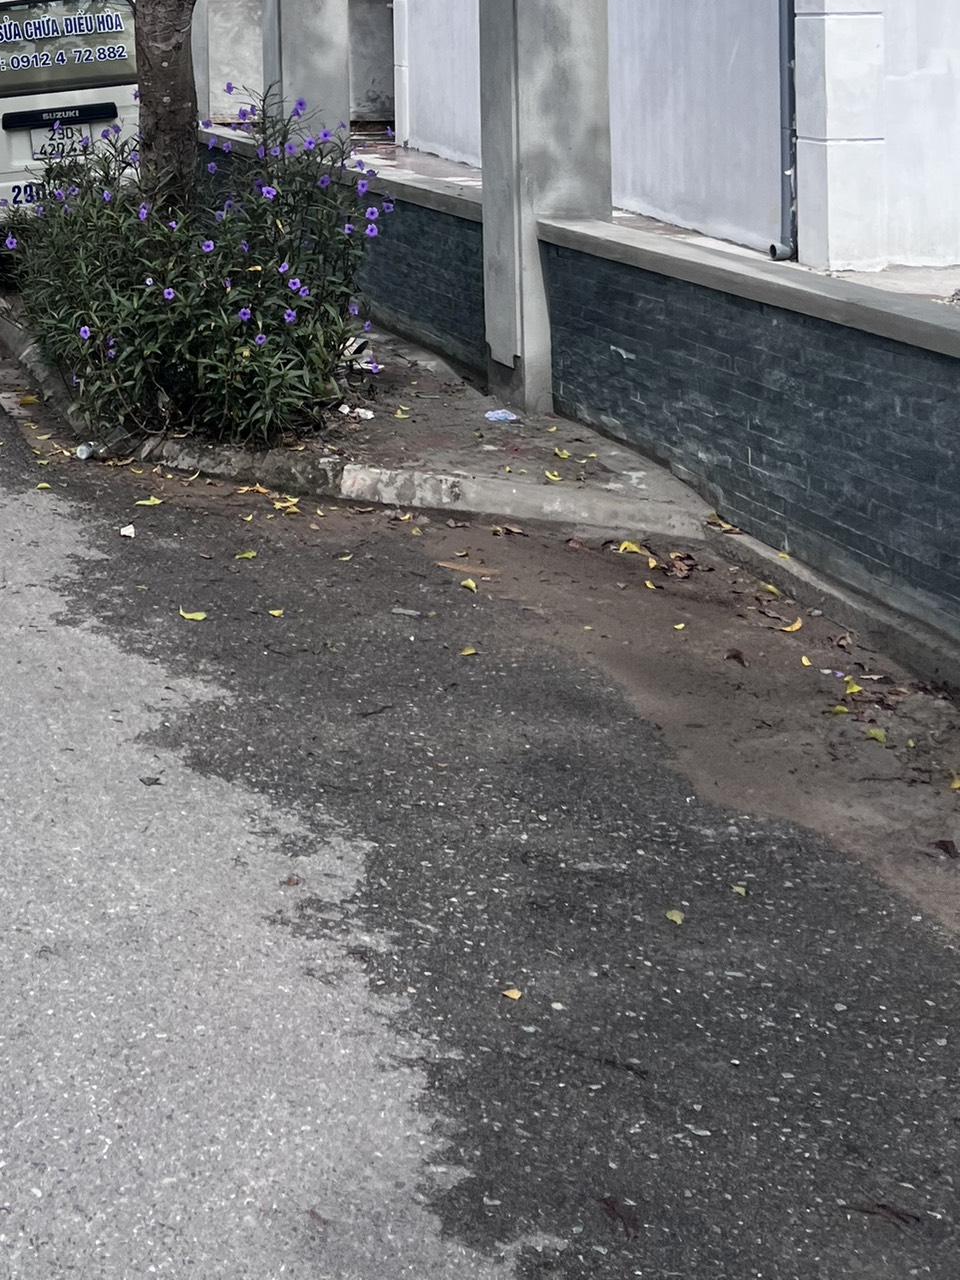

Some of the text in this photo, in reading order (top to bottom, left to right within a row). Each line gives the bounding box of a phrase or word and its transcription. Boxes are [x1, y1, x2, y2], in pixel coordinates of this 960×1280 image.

[24, 15, 60, 40] CHỮA
[64, 10, 93, 36] ĐIỀU
[10, 53, 51, 70] 0912
[56, 51, 66, 65] 4
[73, 49, 94, 64] 72
[97, 45, 127, 61] 882
[42, 110, 79, 120] SUZUKI
